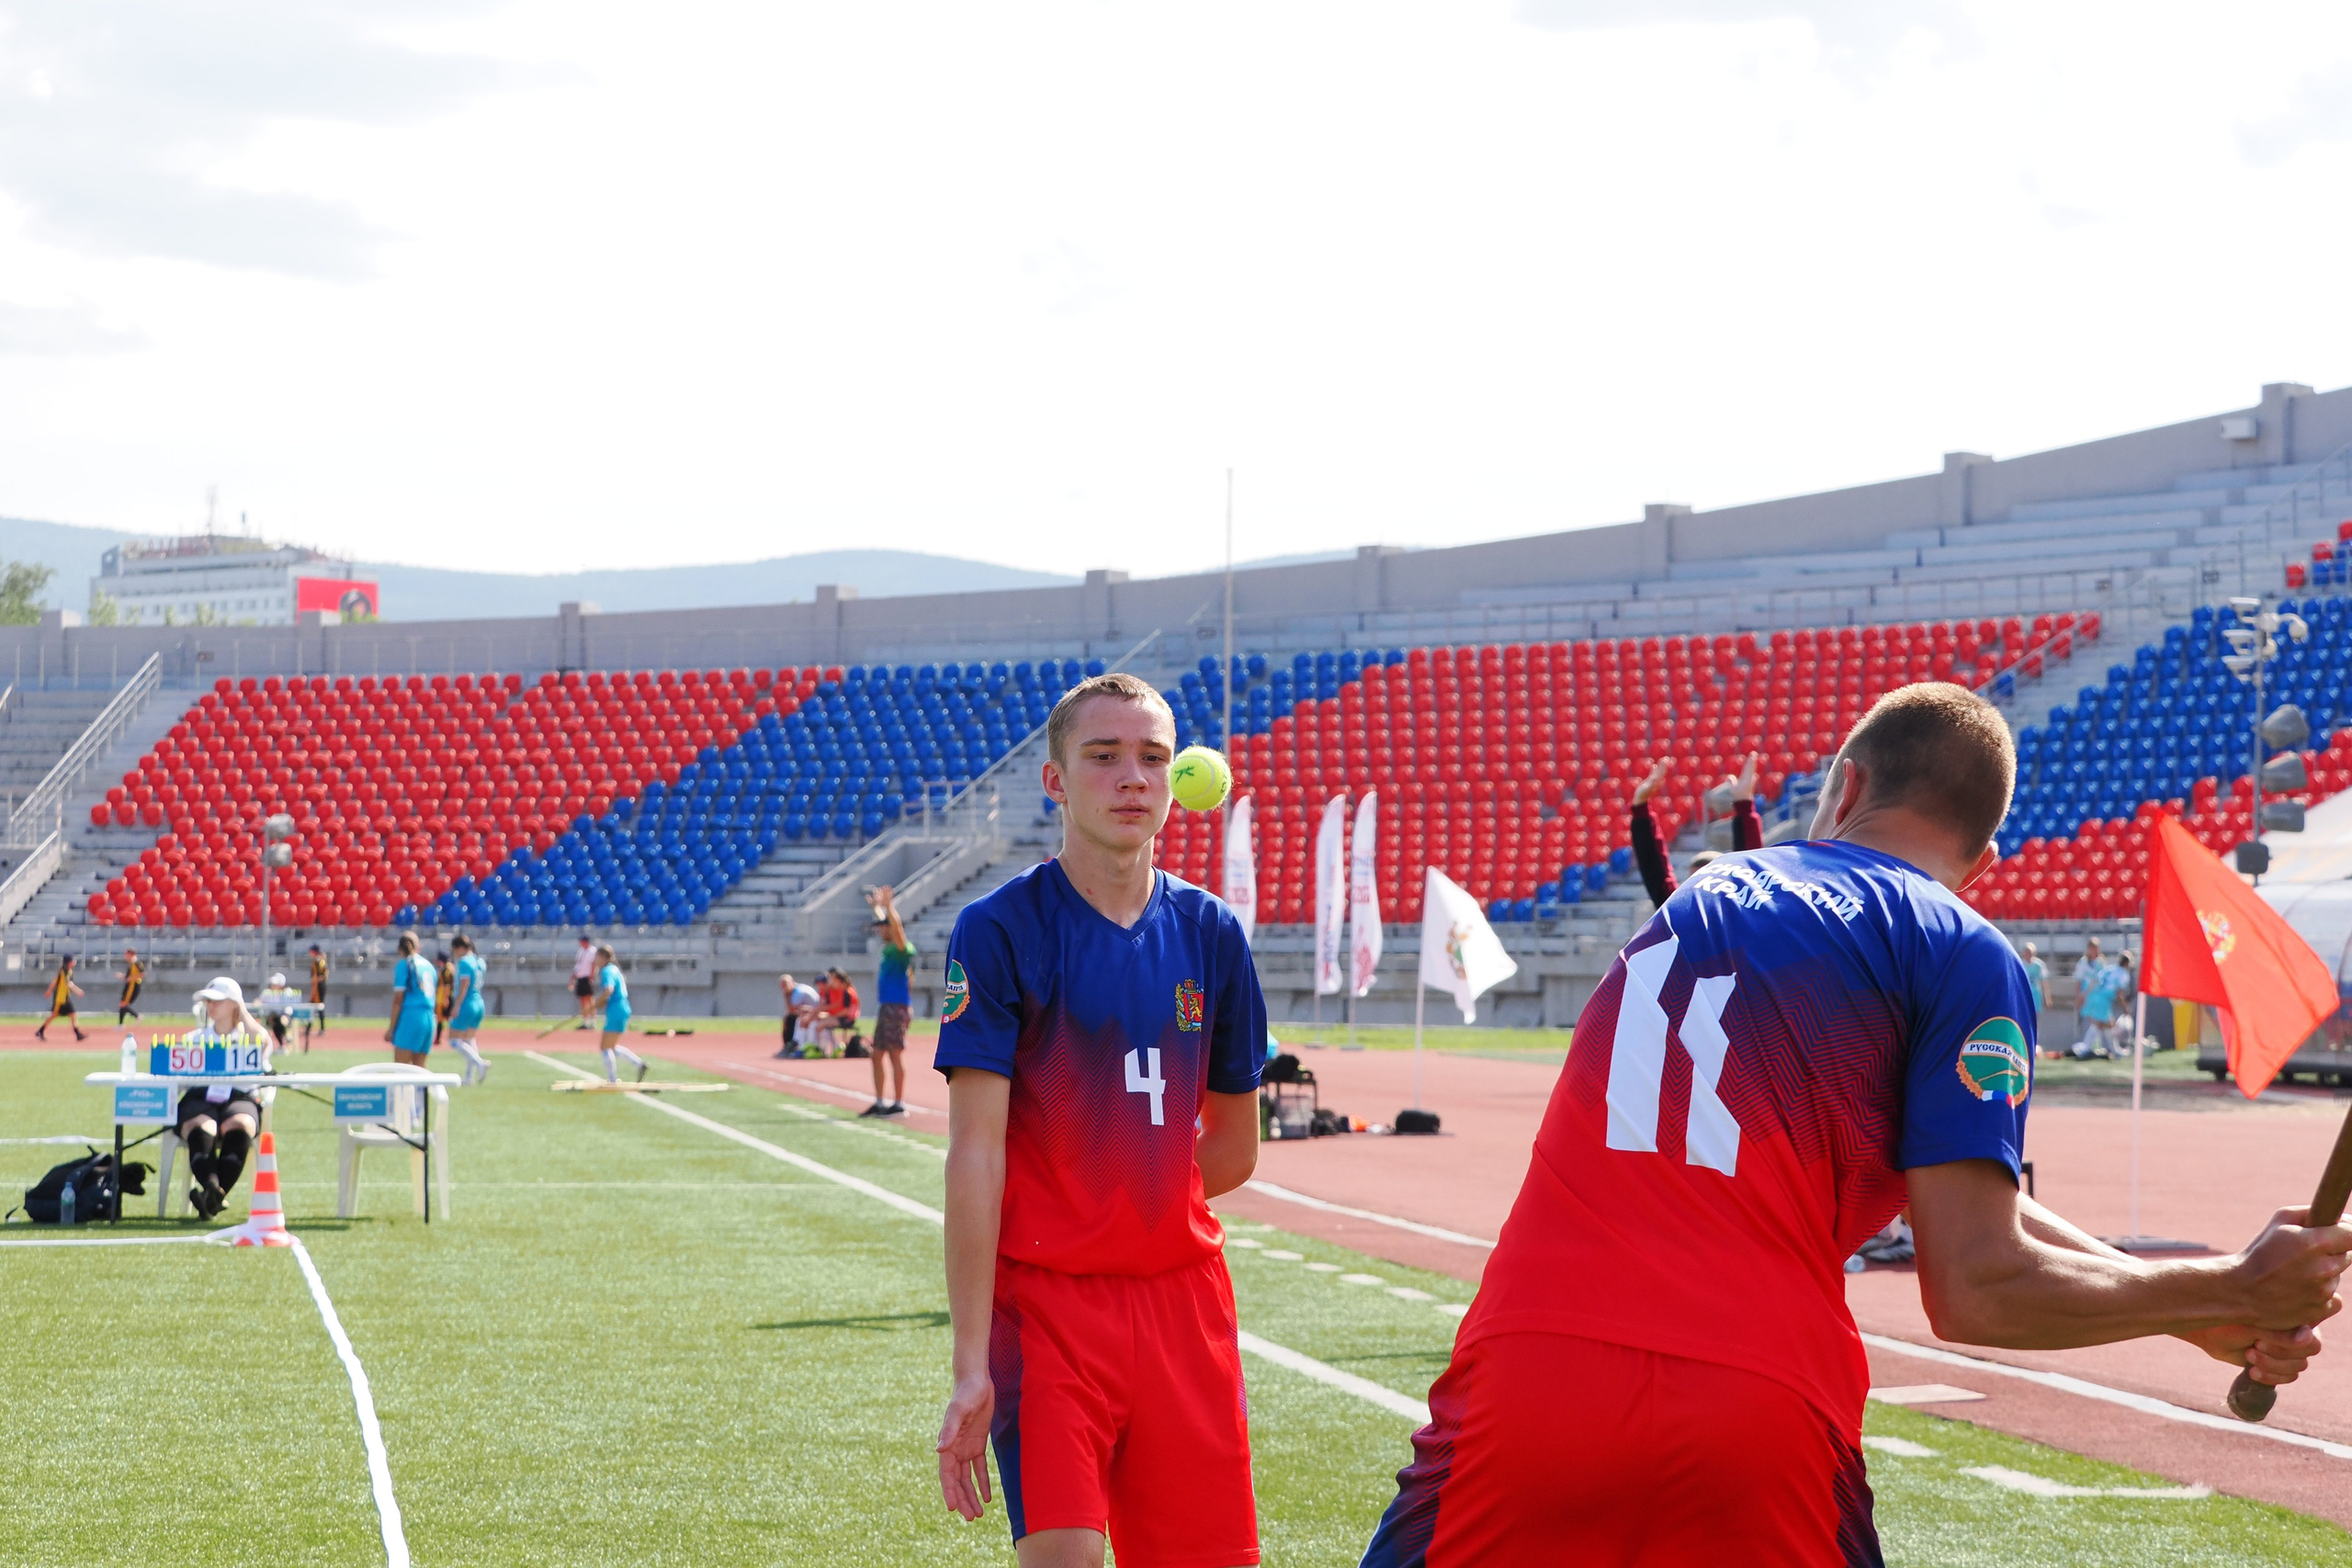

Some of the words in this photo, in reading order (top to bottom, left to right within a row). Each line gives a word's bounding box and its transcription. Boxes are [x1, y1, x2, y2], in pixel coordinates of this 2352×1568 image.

[1692, 863, 1865, 921] СНОЯРСКИЙ
[1694, 875, 1773, 910] КРАЙ
[172, 1047, 204, 1069] 50
[232, 1047, 258, 1069] 14
[1124, 1047, 1167, 1125] 4
